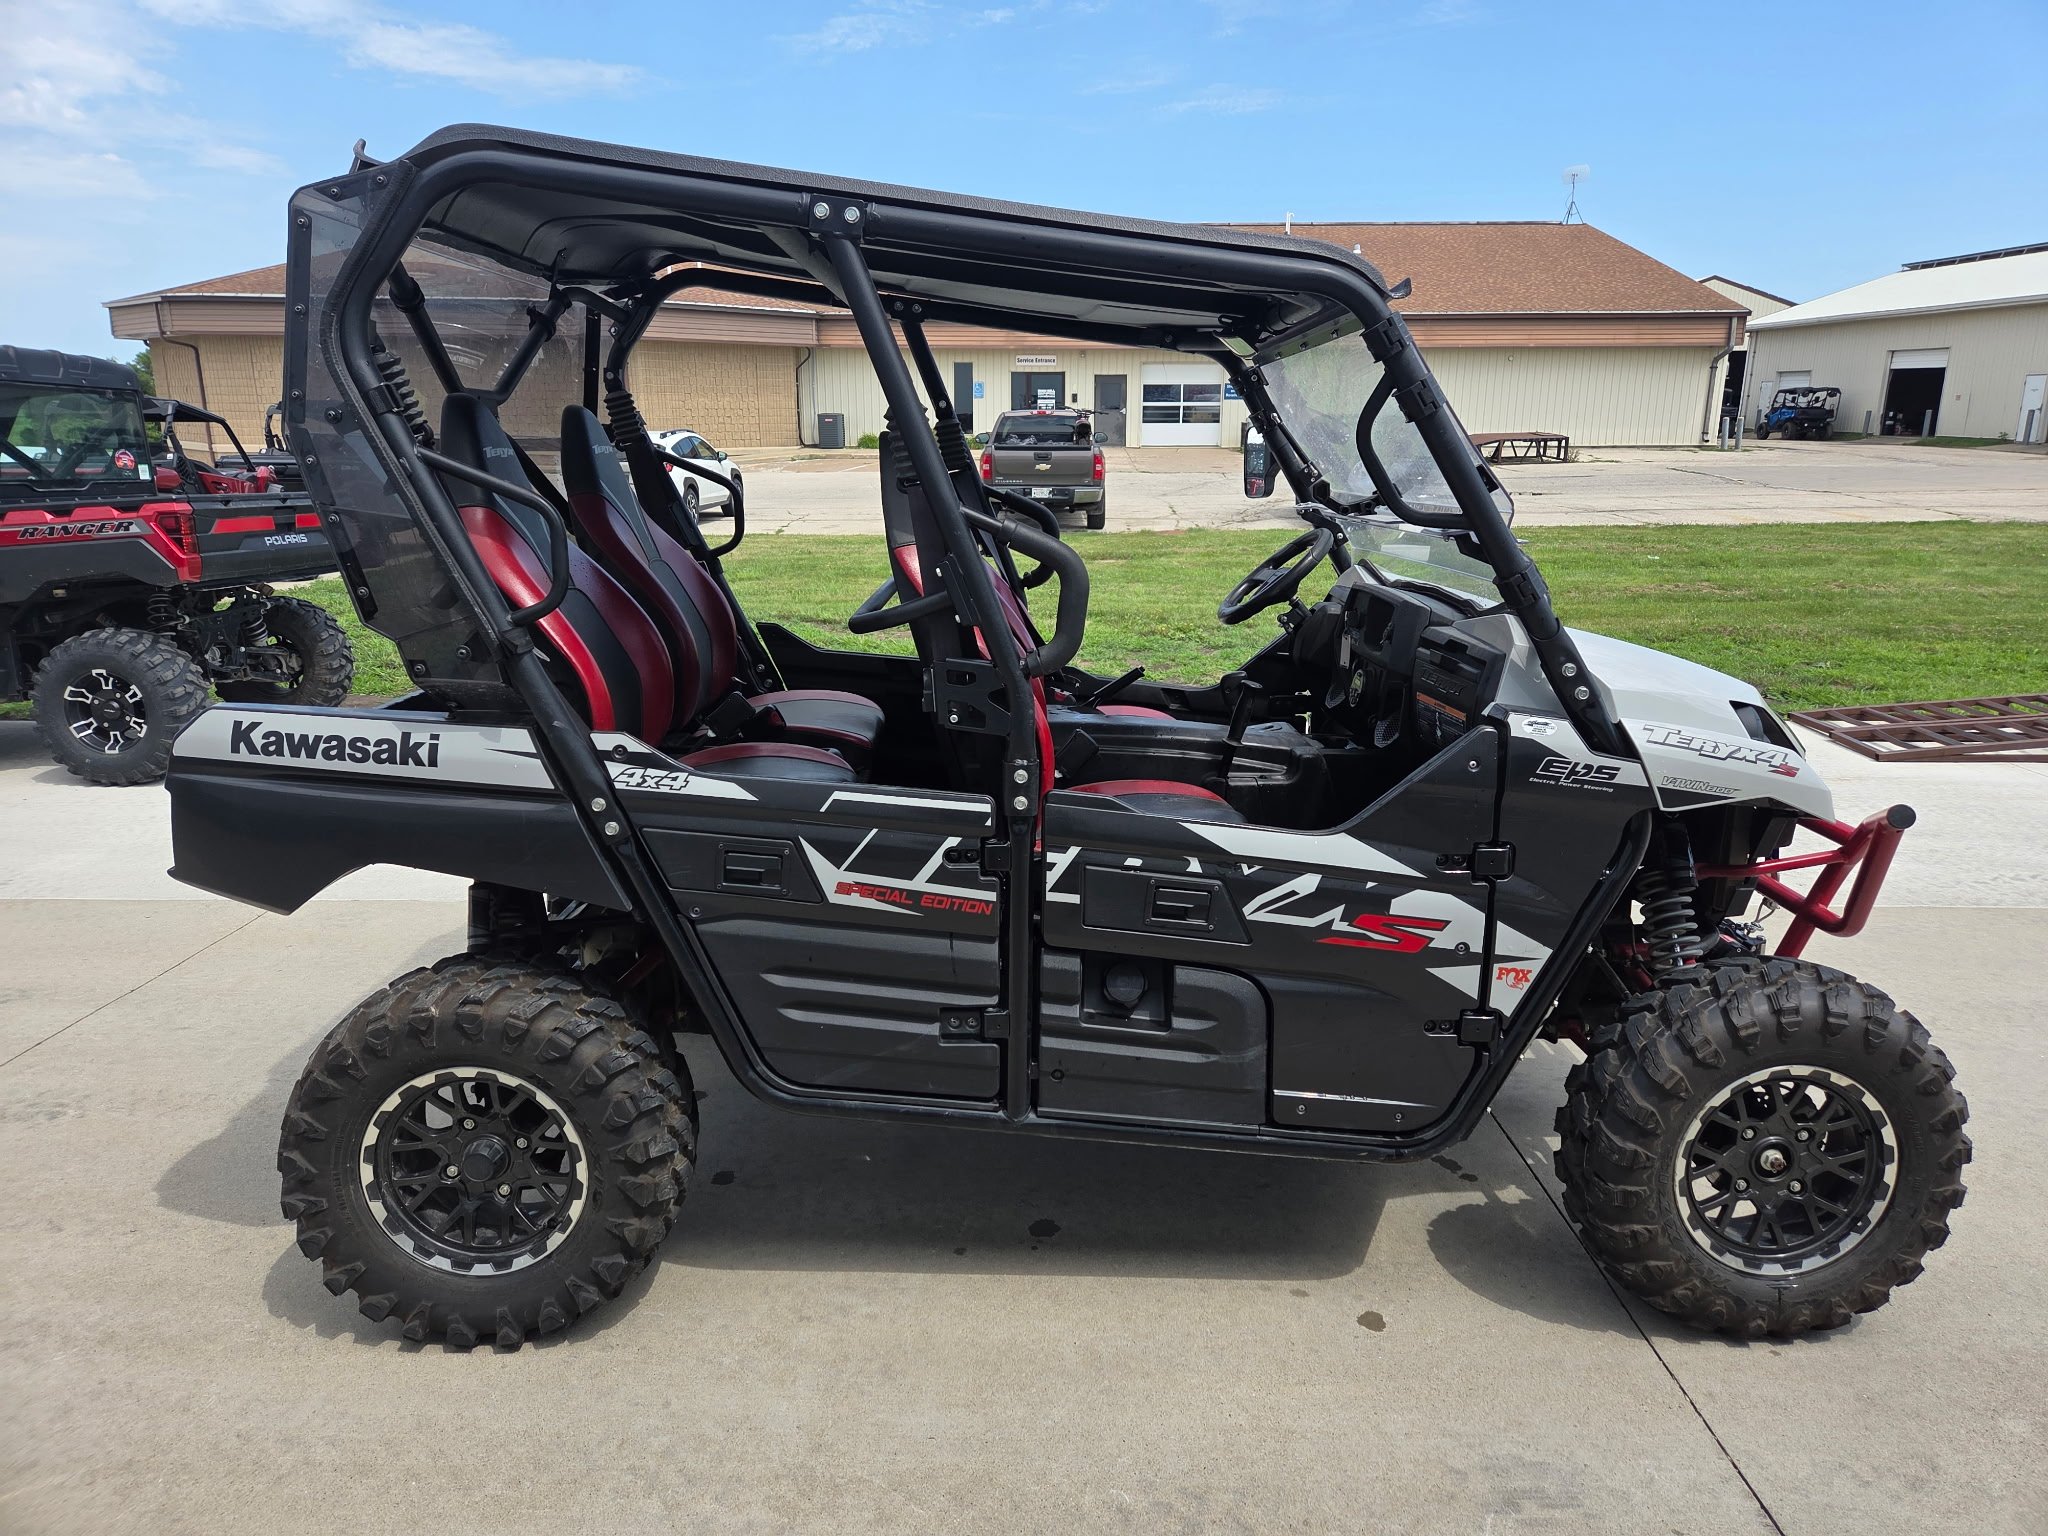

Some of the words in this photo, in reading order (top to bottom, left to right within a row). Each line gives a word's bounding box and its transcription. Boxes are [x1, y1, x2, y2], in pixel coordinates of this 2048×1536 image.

[17, 519, 135, 540] RANGER
[265, 533, 308, 547] POLARIS
[230, 719, 440, 768] Kawasaki
[613, 767, 690, 791] 4x4
[1536, 757, 1621, 782] EPS
[1529, 777, 1555, 785] Electric
[1583, 784, 1614, 793] Steering
[834, 881, 913, 904] SPECIAL
[920, 894, 993, 916] EDITION
[1496, 967, 1533, 986] FOX
